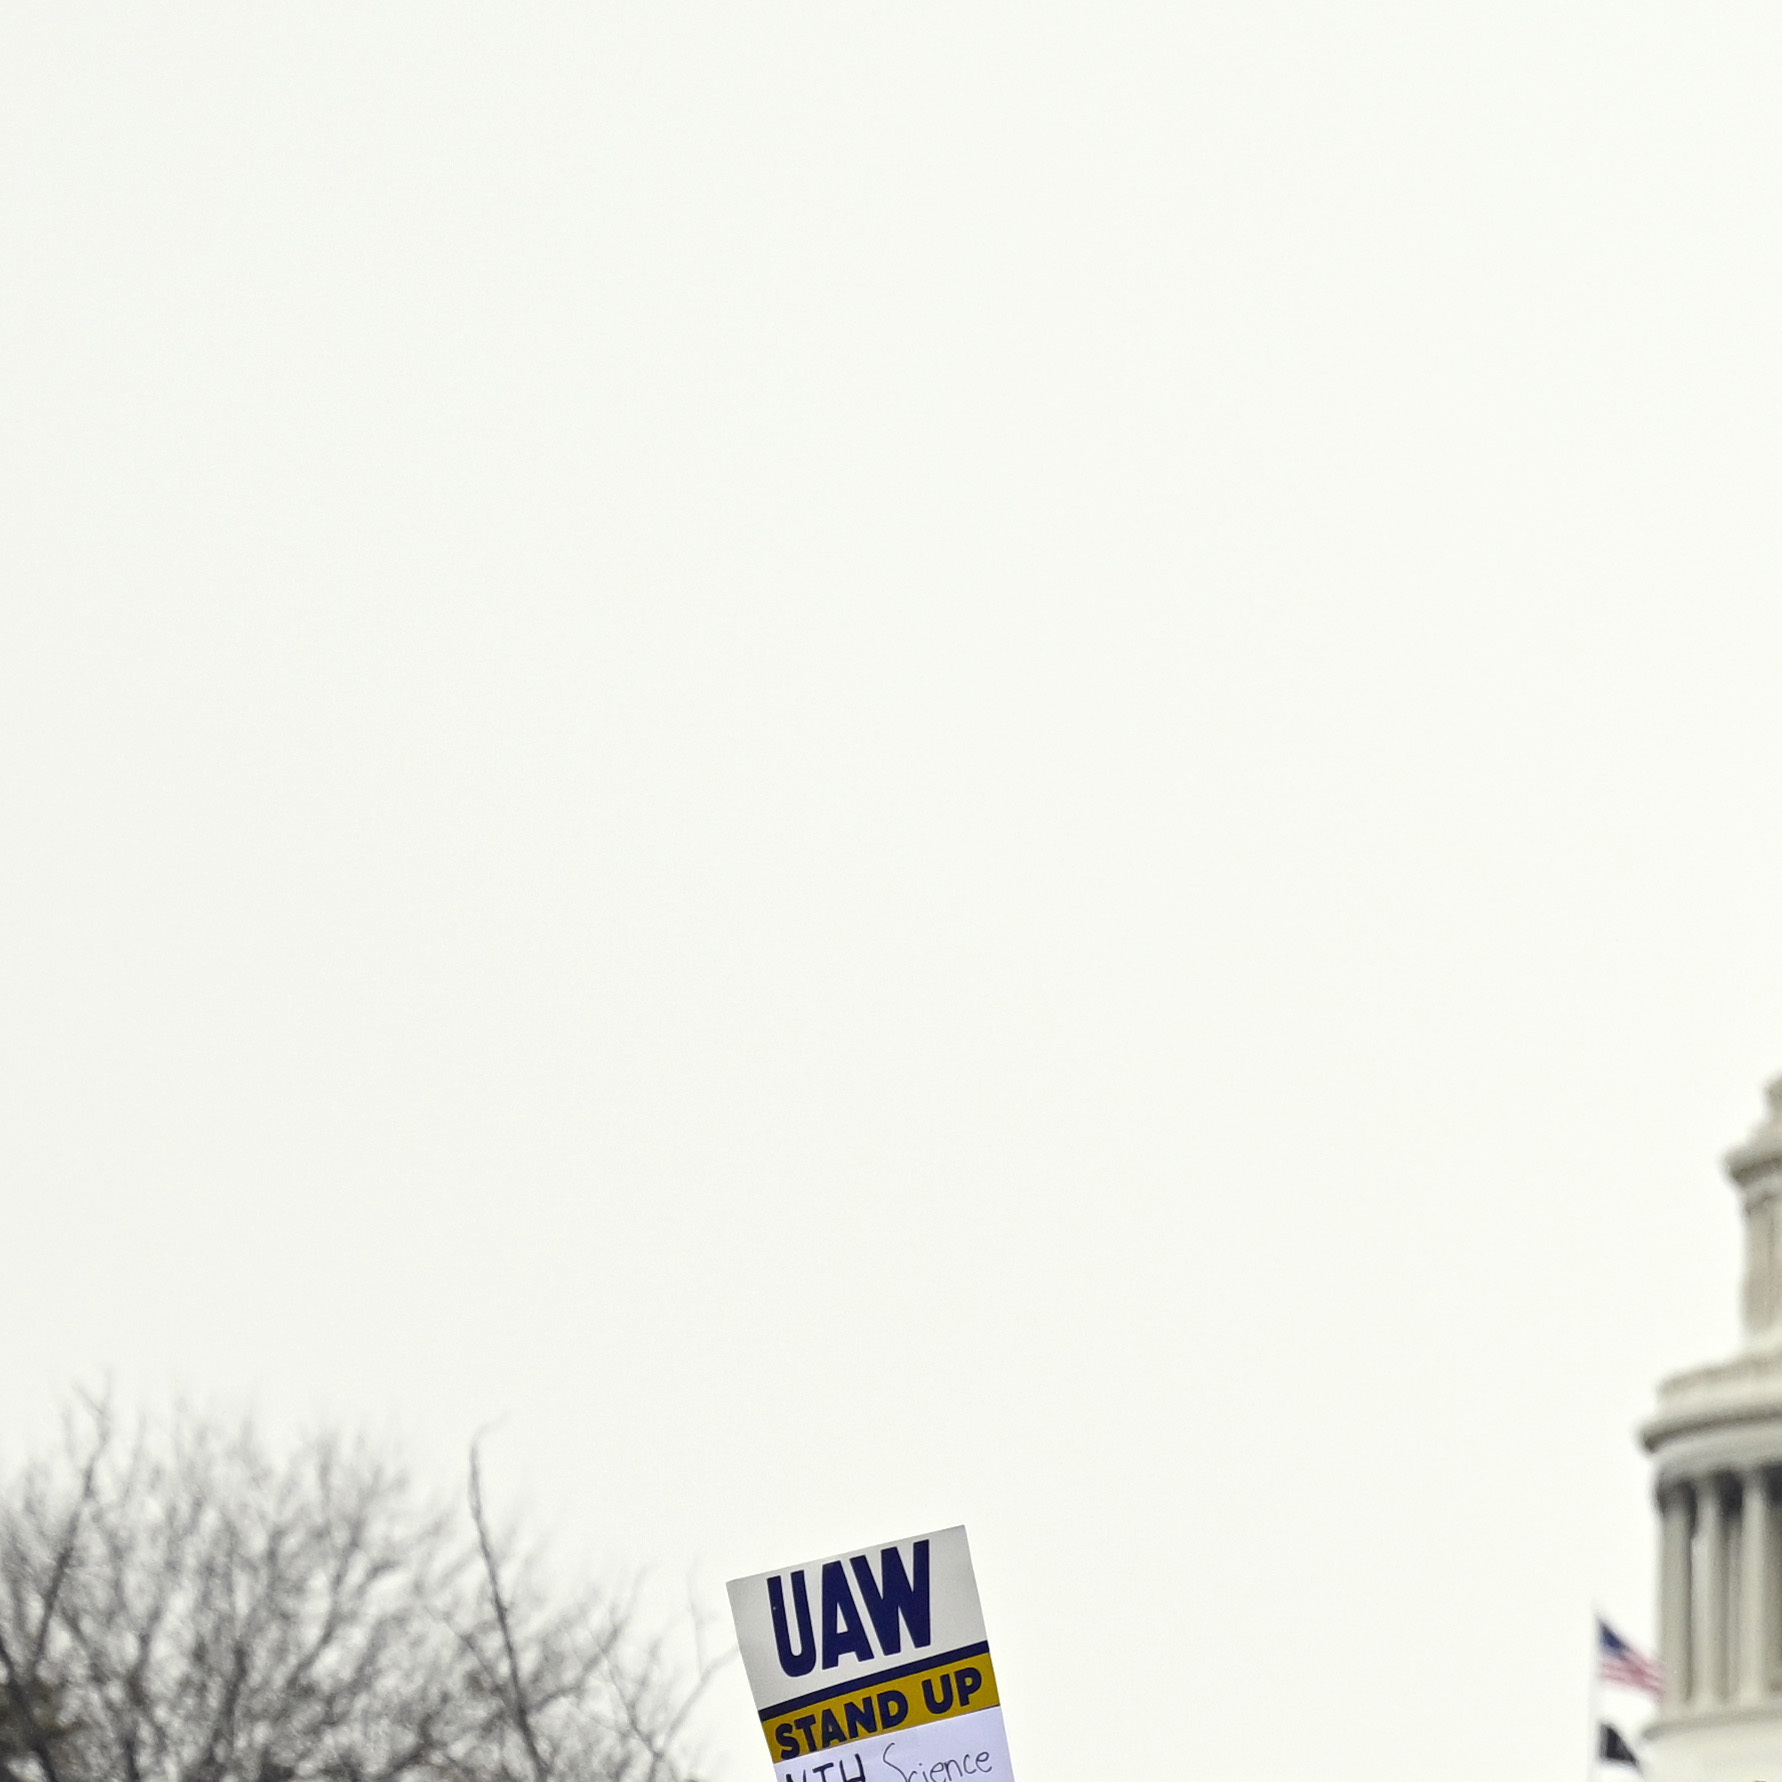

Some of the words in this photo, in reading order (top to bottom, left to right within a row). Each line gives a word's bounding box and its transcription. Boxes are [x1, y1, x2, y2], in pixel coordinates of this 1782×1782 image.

[767, 1539, 931, 1677] UAW
[774, 1689, 909, 1761] STAND
[922, 1666, 983, 1714] UP
